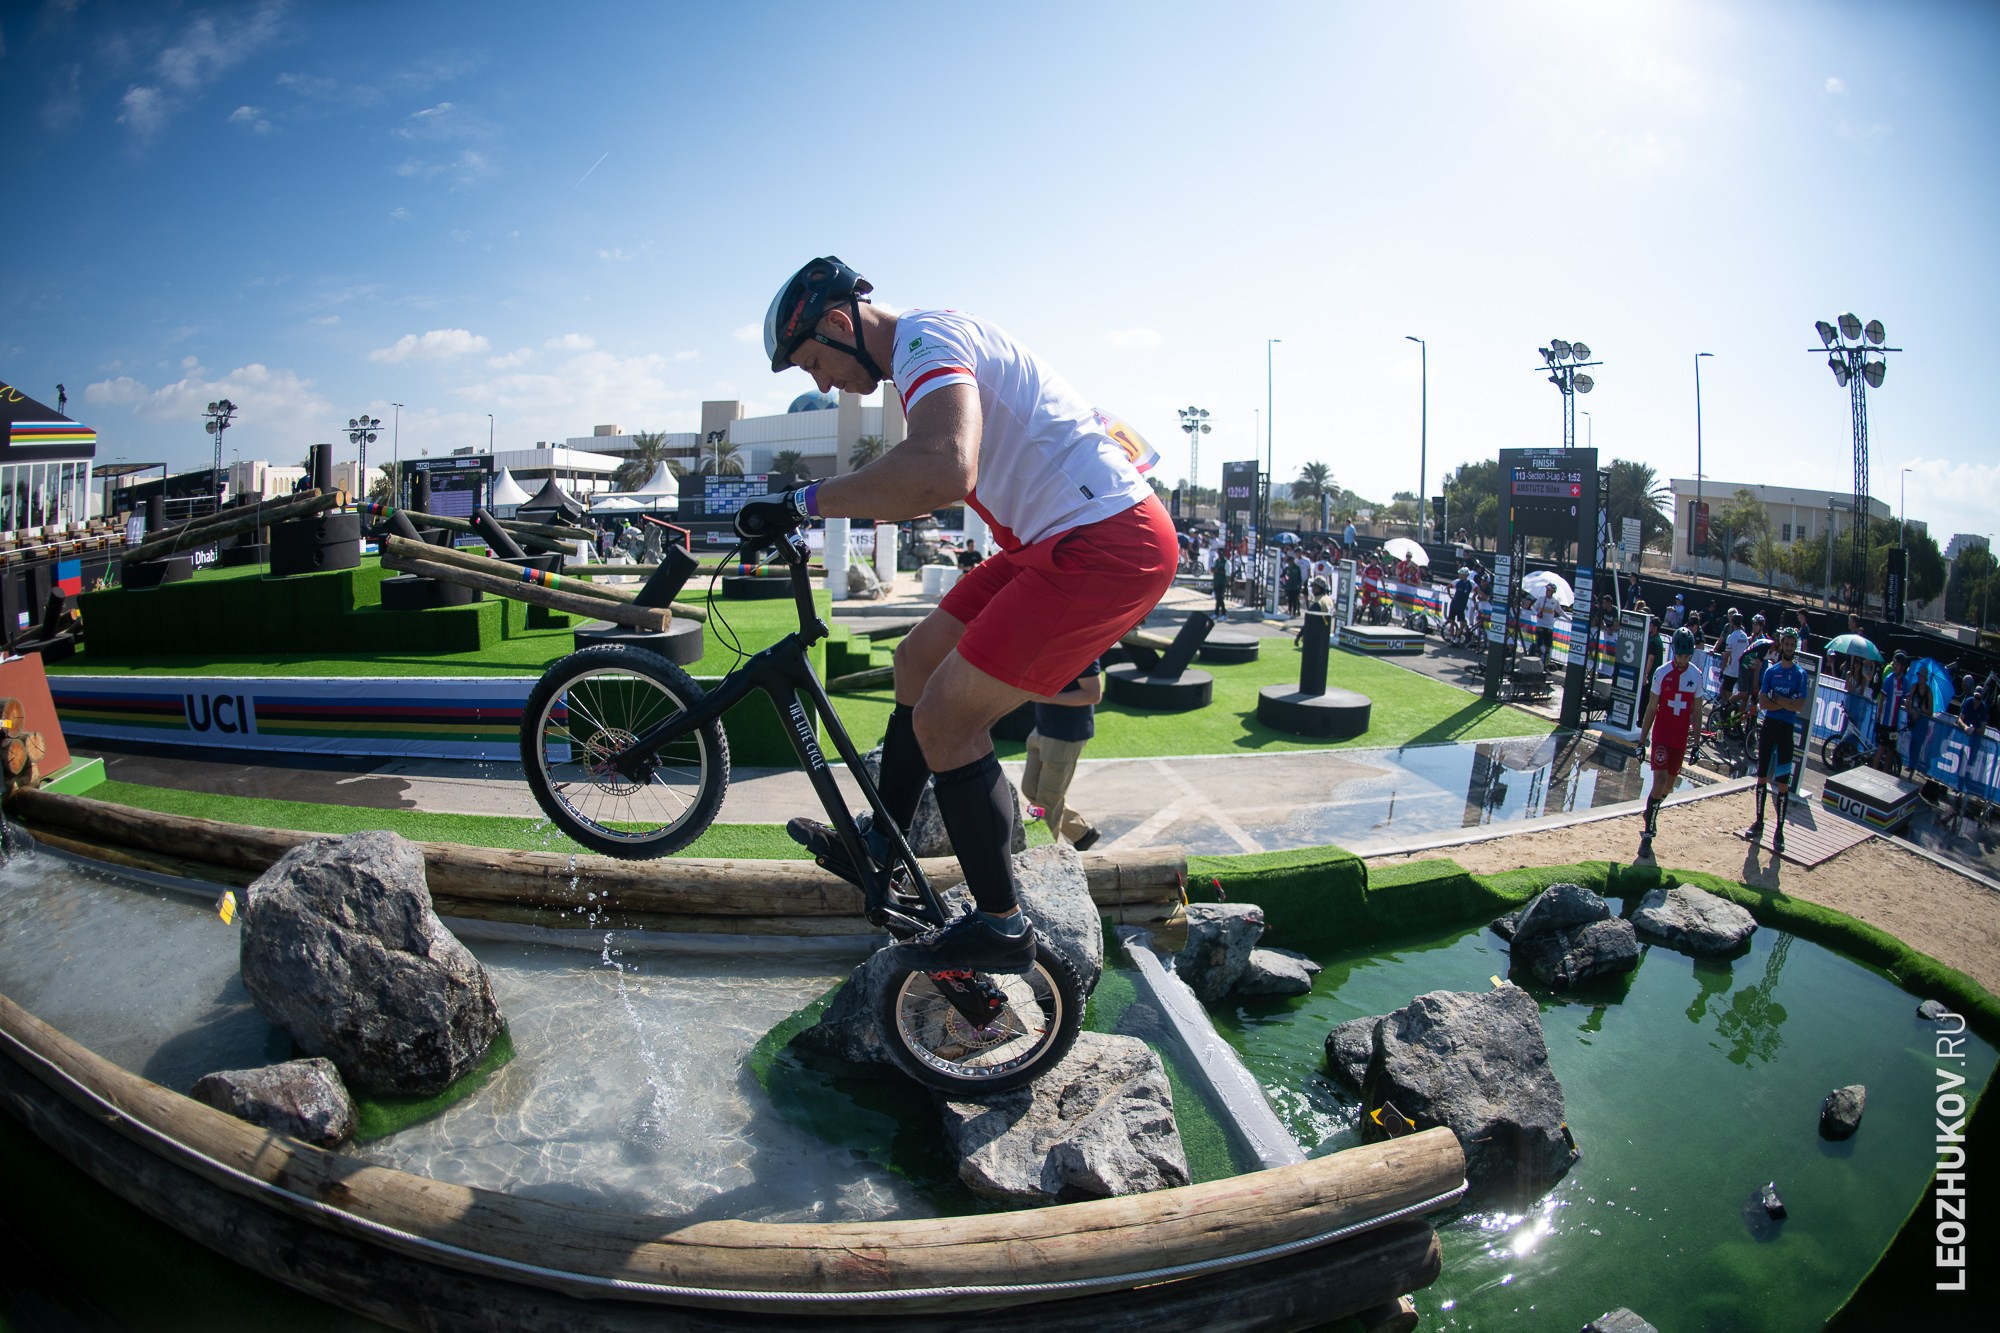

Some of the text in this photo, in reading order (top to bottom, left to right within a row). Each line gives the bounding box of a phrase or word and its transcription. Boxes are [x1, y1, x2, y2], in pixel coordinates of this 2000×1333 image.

[1532, 459, 1556, 468] FINISH
[1516, 472, 1526, 480] 113
[1568, 473, 1581, 482] 1:52
[1516, 483, 1560, 494] AMSTUTZ Silas
[1571, 505, 1577, 517] 0
[195, 549, 218, 565] Dhabi
[1268, 564, 1275, 577] 2
[1340, 579, 1347, 594] 3
[1619, 629, 1644, 641] FINISH
[1388, 641, 1404, 649] UCI
[1570, 644, 1583, 652] UCI
[1622, 640, 1635, 663] 3
[186, 694, 249, 734] UCI
[789, 702, 825, 771] THE LIFE CYCLE
[1839, 797, 1865, 820] UCI
